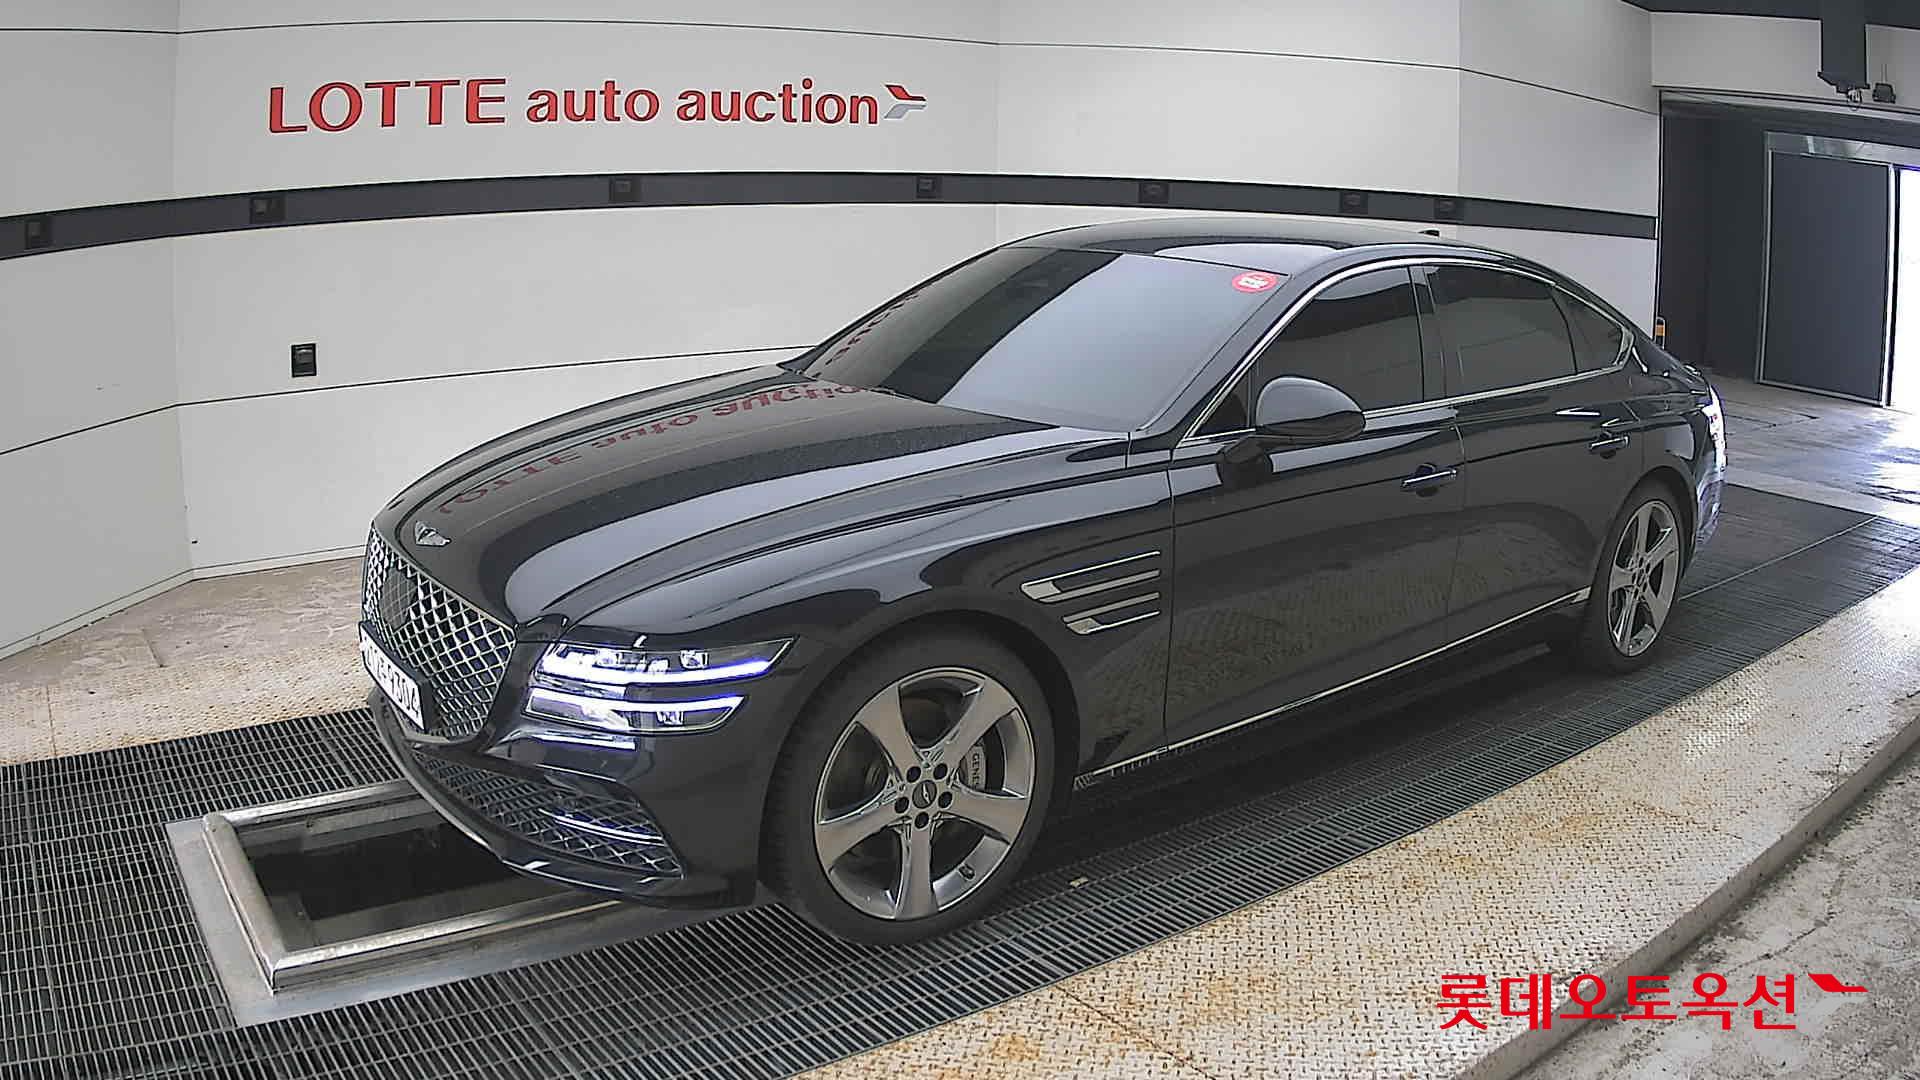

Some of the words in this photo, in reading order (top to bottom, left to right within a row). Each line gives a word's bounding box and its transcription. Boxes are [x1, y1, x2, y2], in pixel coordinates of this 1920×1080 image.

[269, 79, 506, 133] LOTTE
[526, 80, 659, 122] auto
[676, 79, 878, 124] auction
